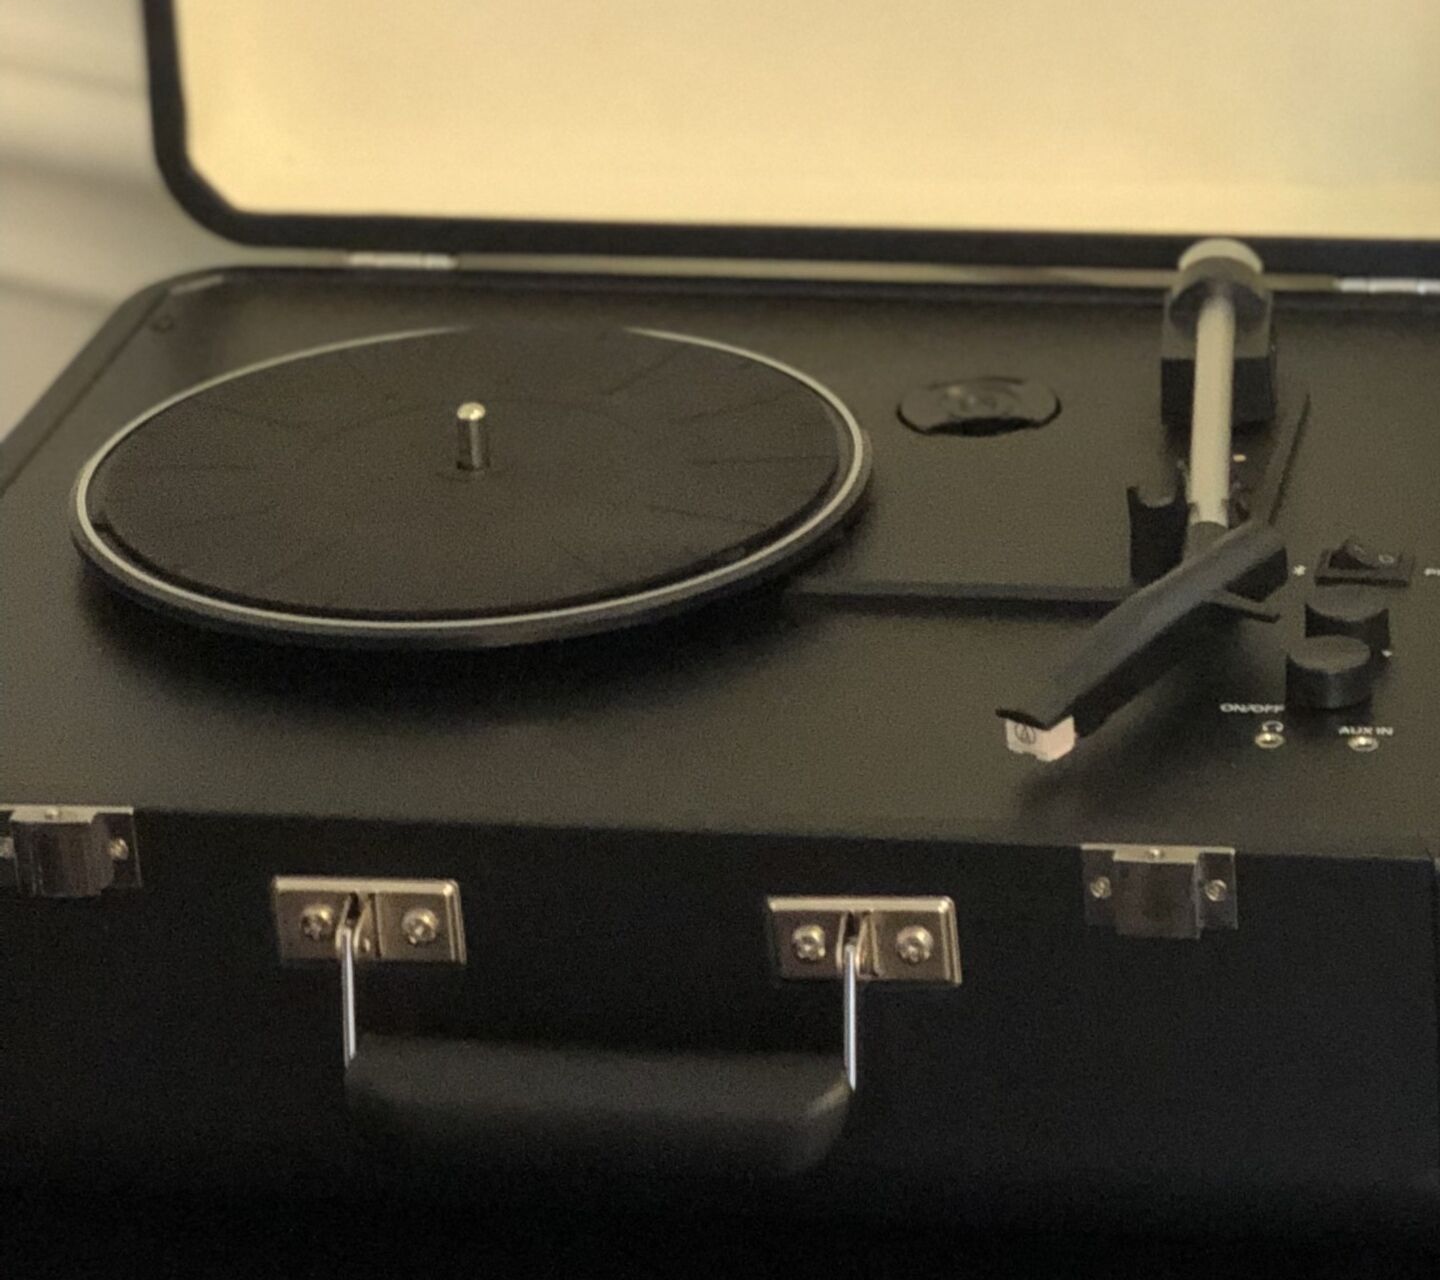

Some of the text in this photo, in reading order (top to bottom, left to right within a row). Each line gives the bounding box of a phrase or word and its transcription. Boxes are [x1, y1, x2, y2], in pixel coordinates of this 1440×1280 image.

[1220, 703, 1285, 714] ON/OFF
[1338, 725, 1394, 736] AUX IN
